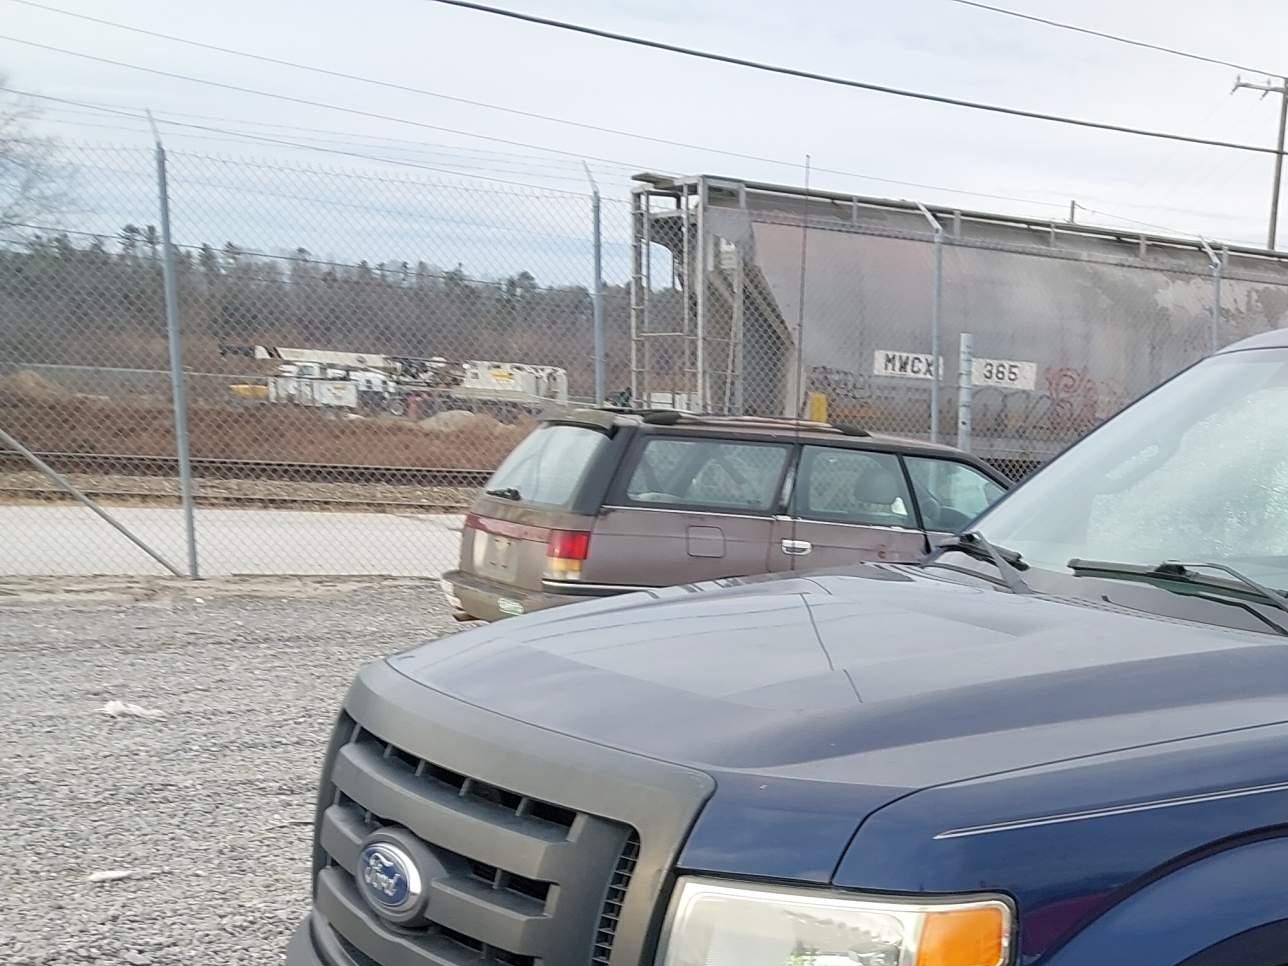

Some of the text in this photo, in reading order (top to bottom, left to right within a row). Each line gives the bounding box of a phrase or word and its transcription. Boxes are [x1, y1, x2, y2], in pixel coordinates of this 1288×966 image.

[884, 352, 1019, 383] MWCX 365
[364, 852, 401, 897] Ford
